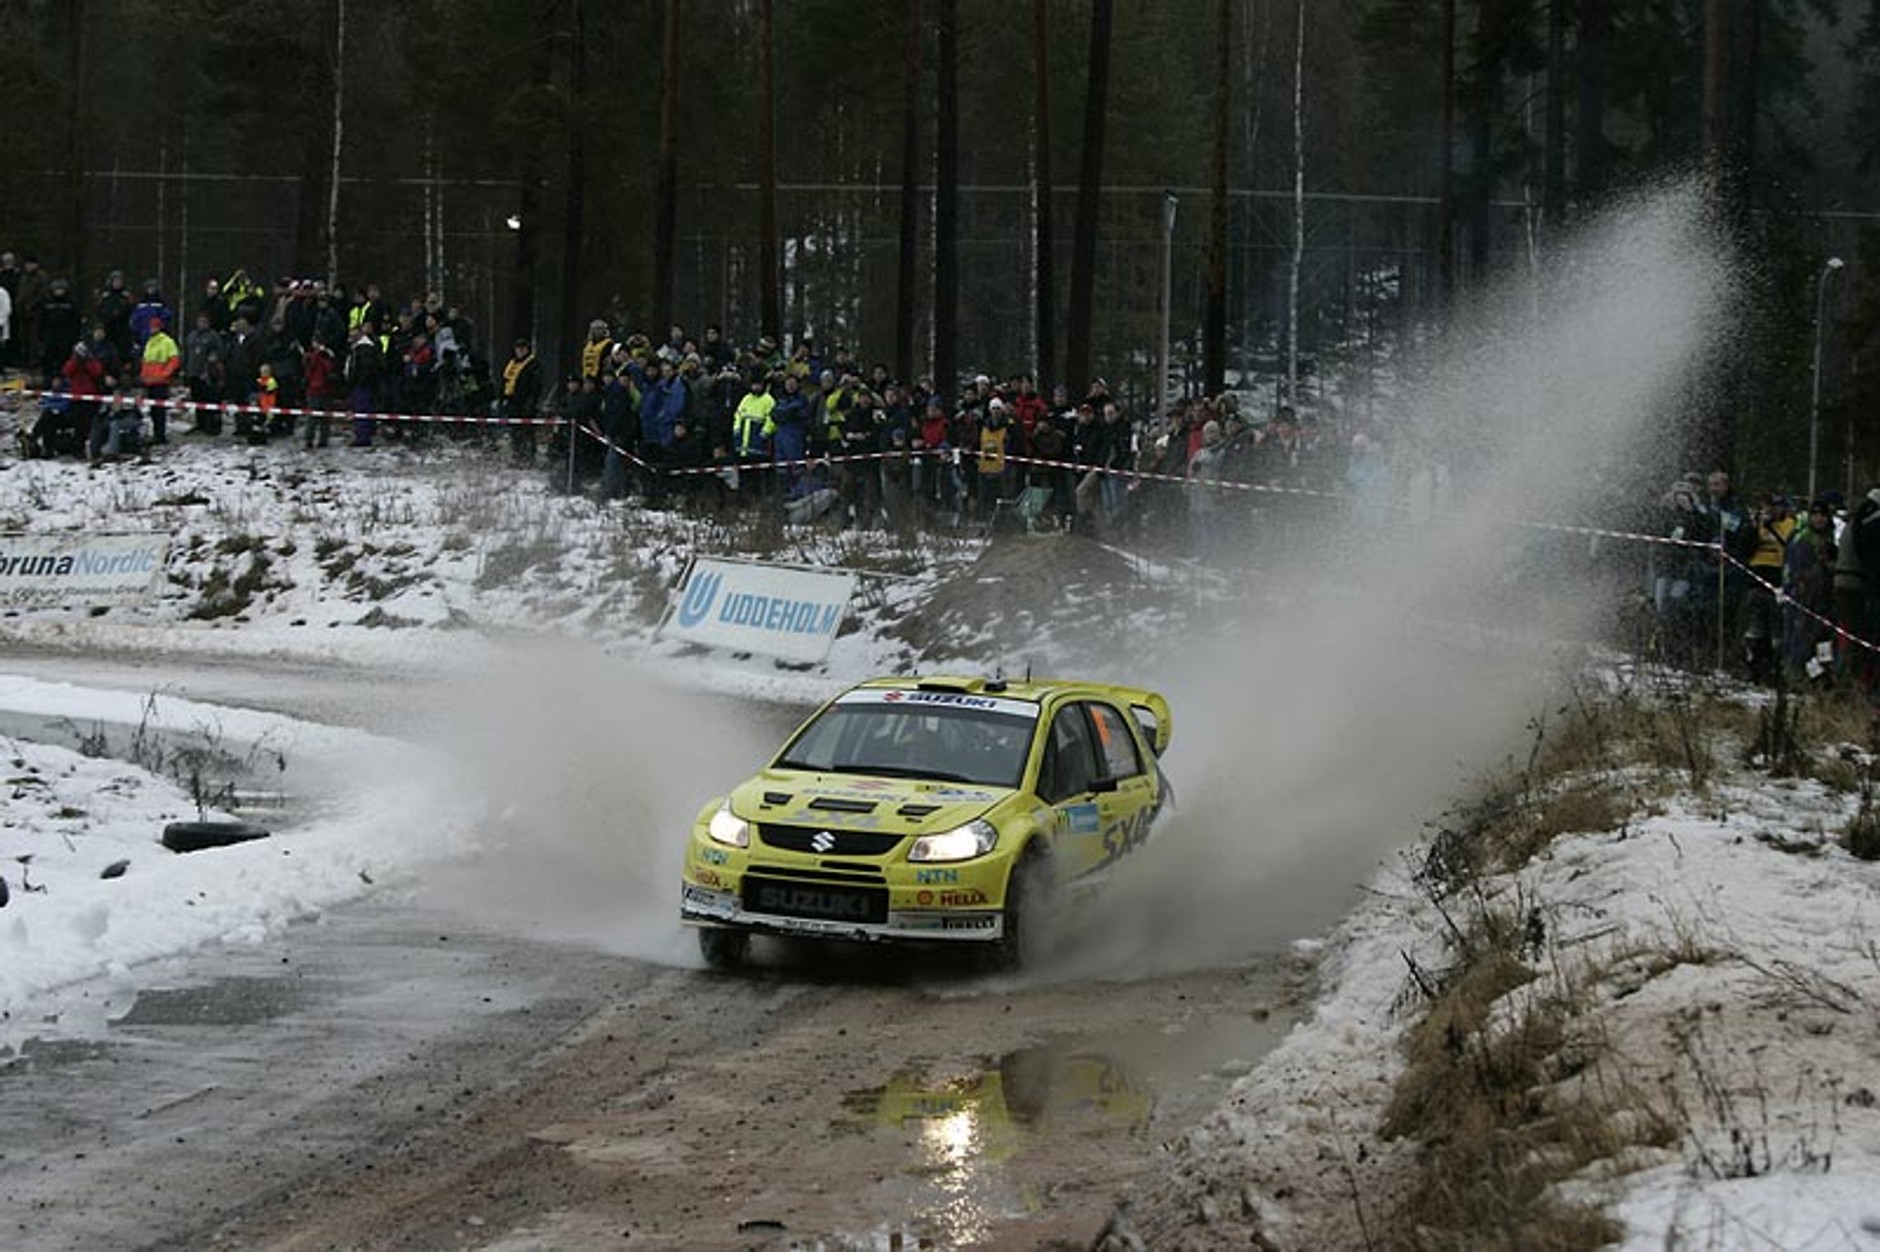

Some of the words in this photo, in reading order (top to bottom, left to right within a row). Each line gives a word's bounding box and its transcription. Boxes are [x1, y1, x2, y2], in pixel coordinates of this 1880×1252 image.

[719, 592, 841, 634] UDDEHOLM
[909, 692, 996, 708] SUZUKI
[917, 869, 958, 883] NTN
[760, 887, 868, 915] SUZUKI
[941, 890, 988, 905] HELIX
